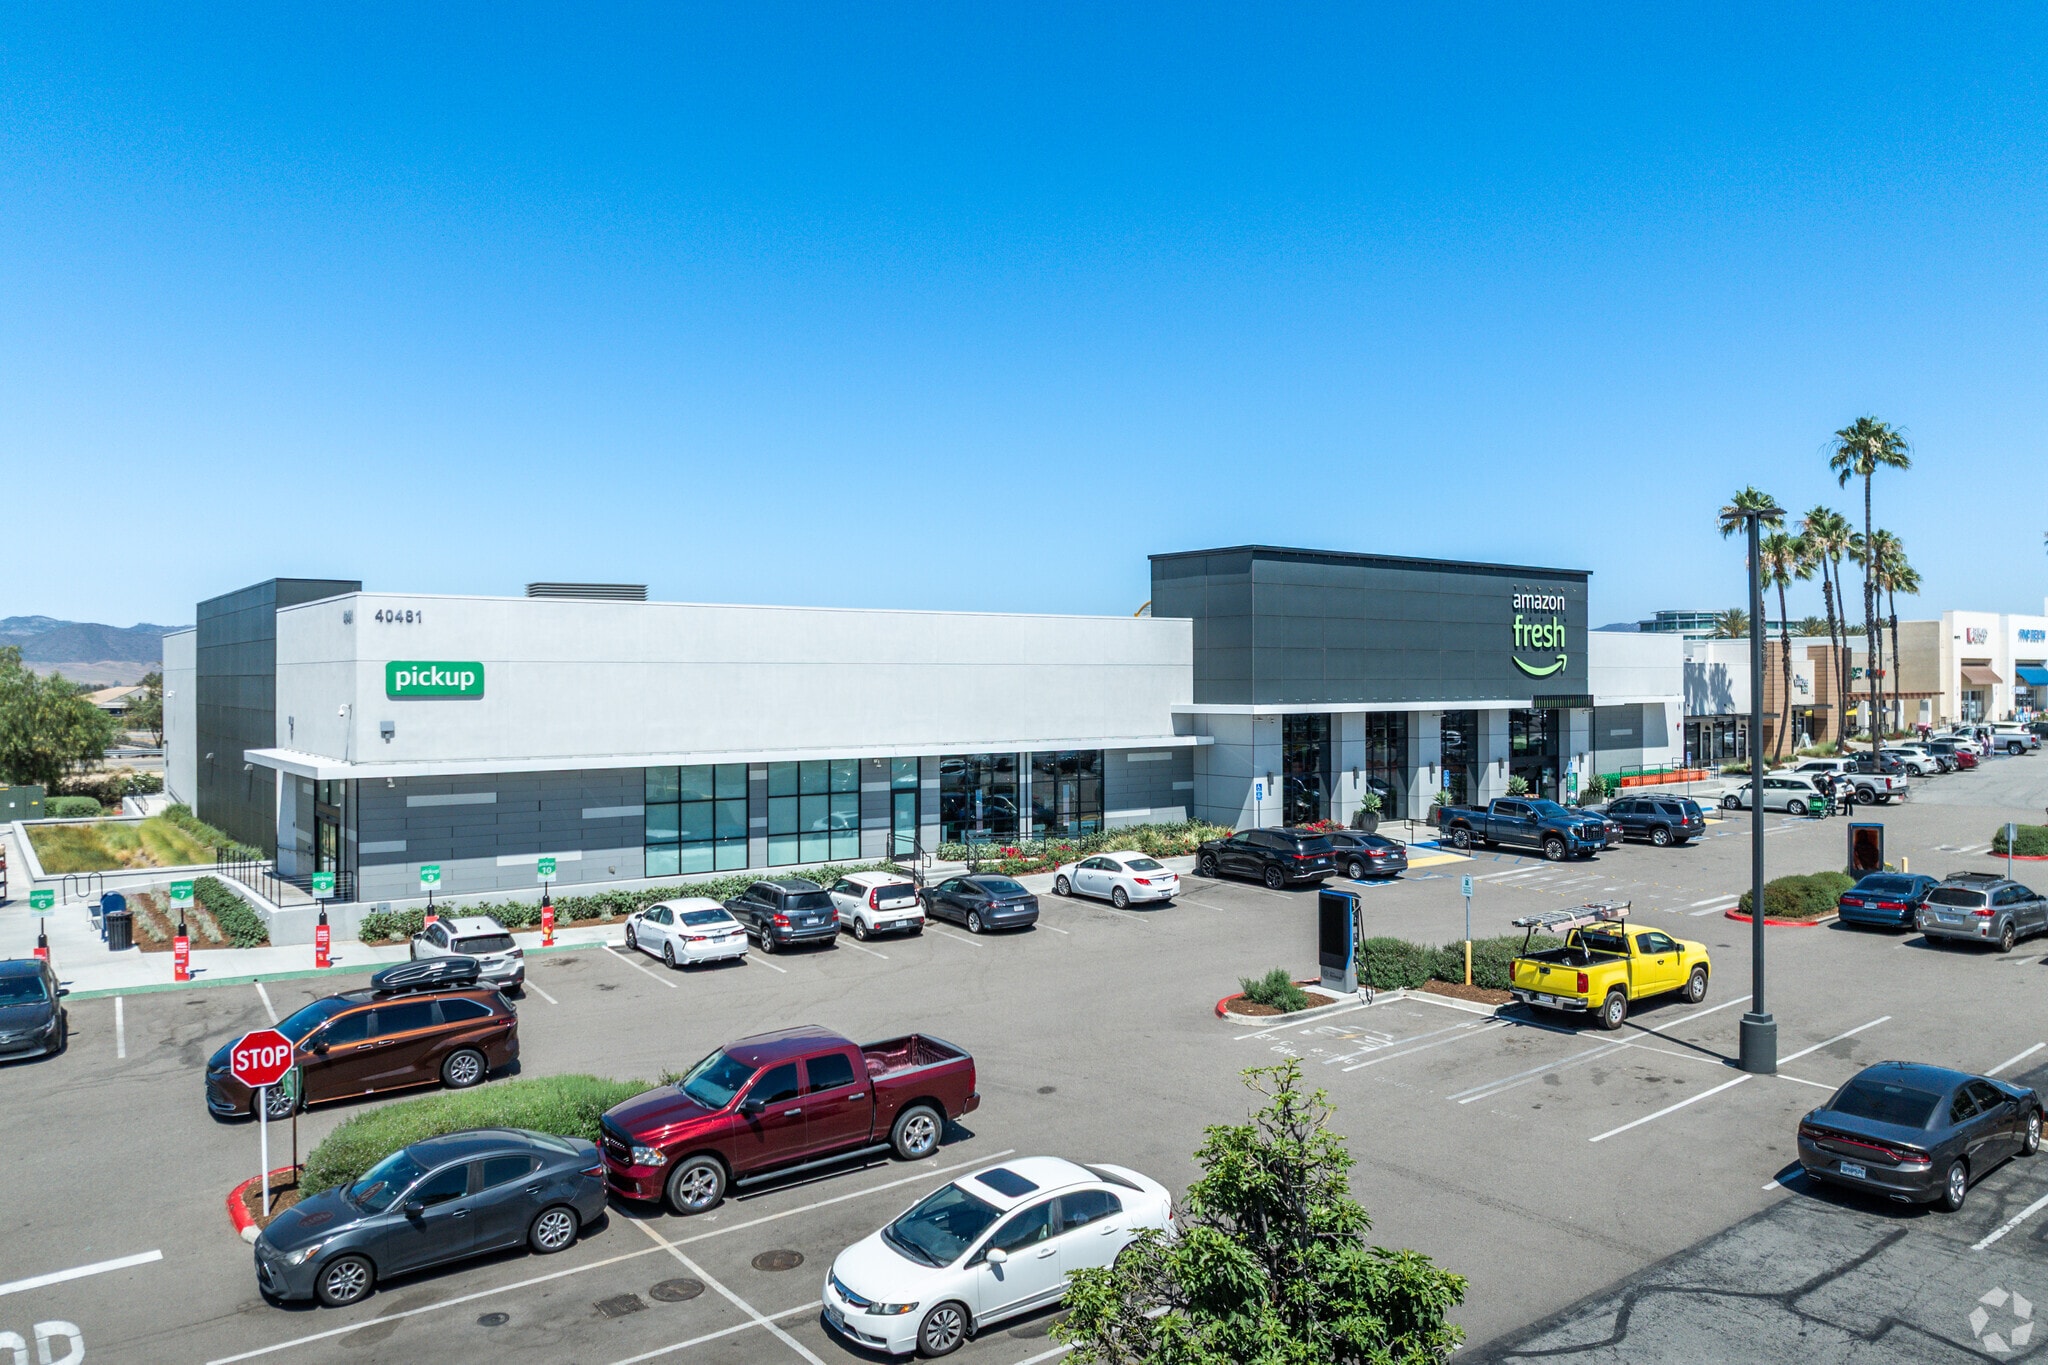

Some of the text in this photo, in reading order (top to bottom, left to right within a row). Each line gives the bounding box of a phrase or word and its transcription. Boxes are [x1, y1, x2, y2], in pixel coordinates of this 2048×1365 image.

[1513, 593, 1565, 610] amazon
[375, 609, 422, 624] 40481
[1513, 614, 1565, 648] fresh
[395, 665, 475, 691] pickup
[541, 866, 552, 874] 10
[427, 874, 434, 882] 9
[179, 891, 186, 899] 7
[39, 899, 46, 909] 6
[235, 1044, 289, 1072] STOP
